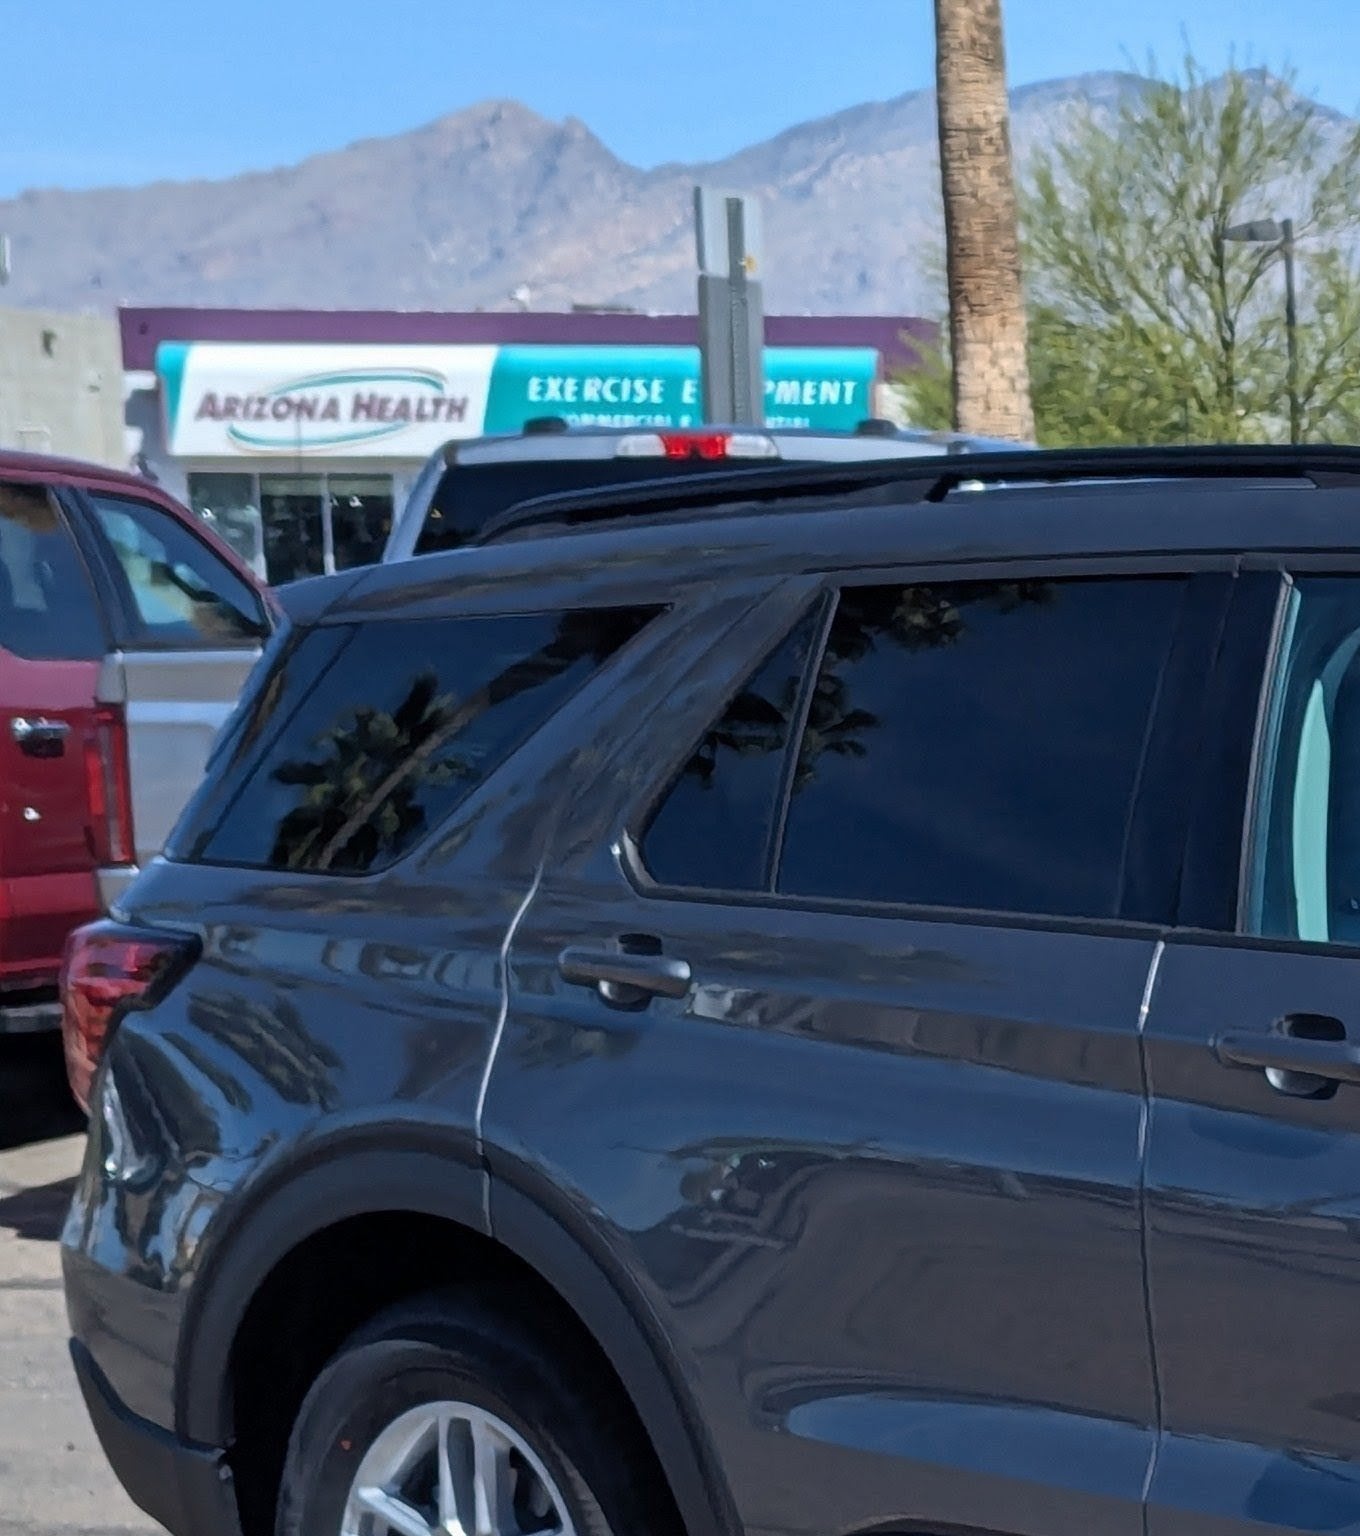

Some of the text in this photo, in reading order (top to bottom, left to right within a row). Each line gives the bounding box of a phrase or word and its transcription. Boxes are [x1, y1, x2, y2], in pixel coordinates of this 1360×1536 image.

[527, 376, 858, 405] EXERCISE EPMENT
[195, 392, 468, 422] ARIZONA HEALTH
